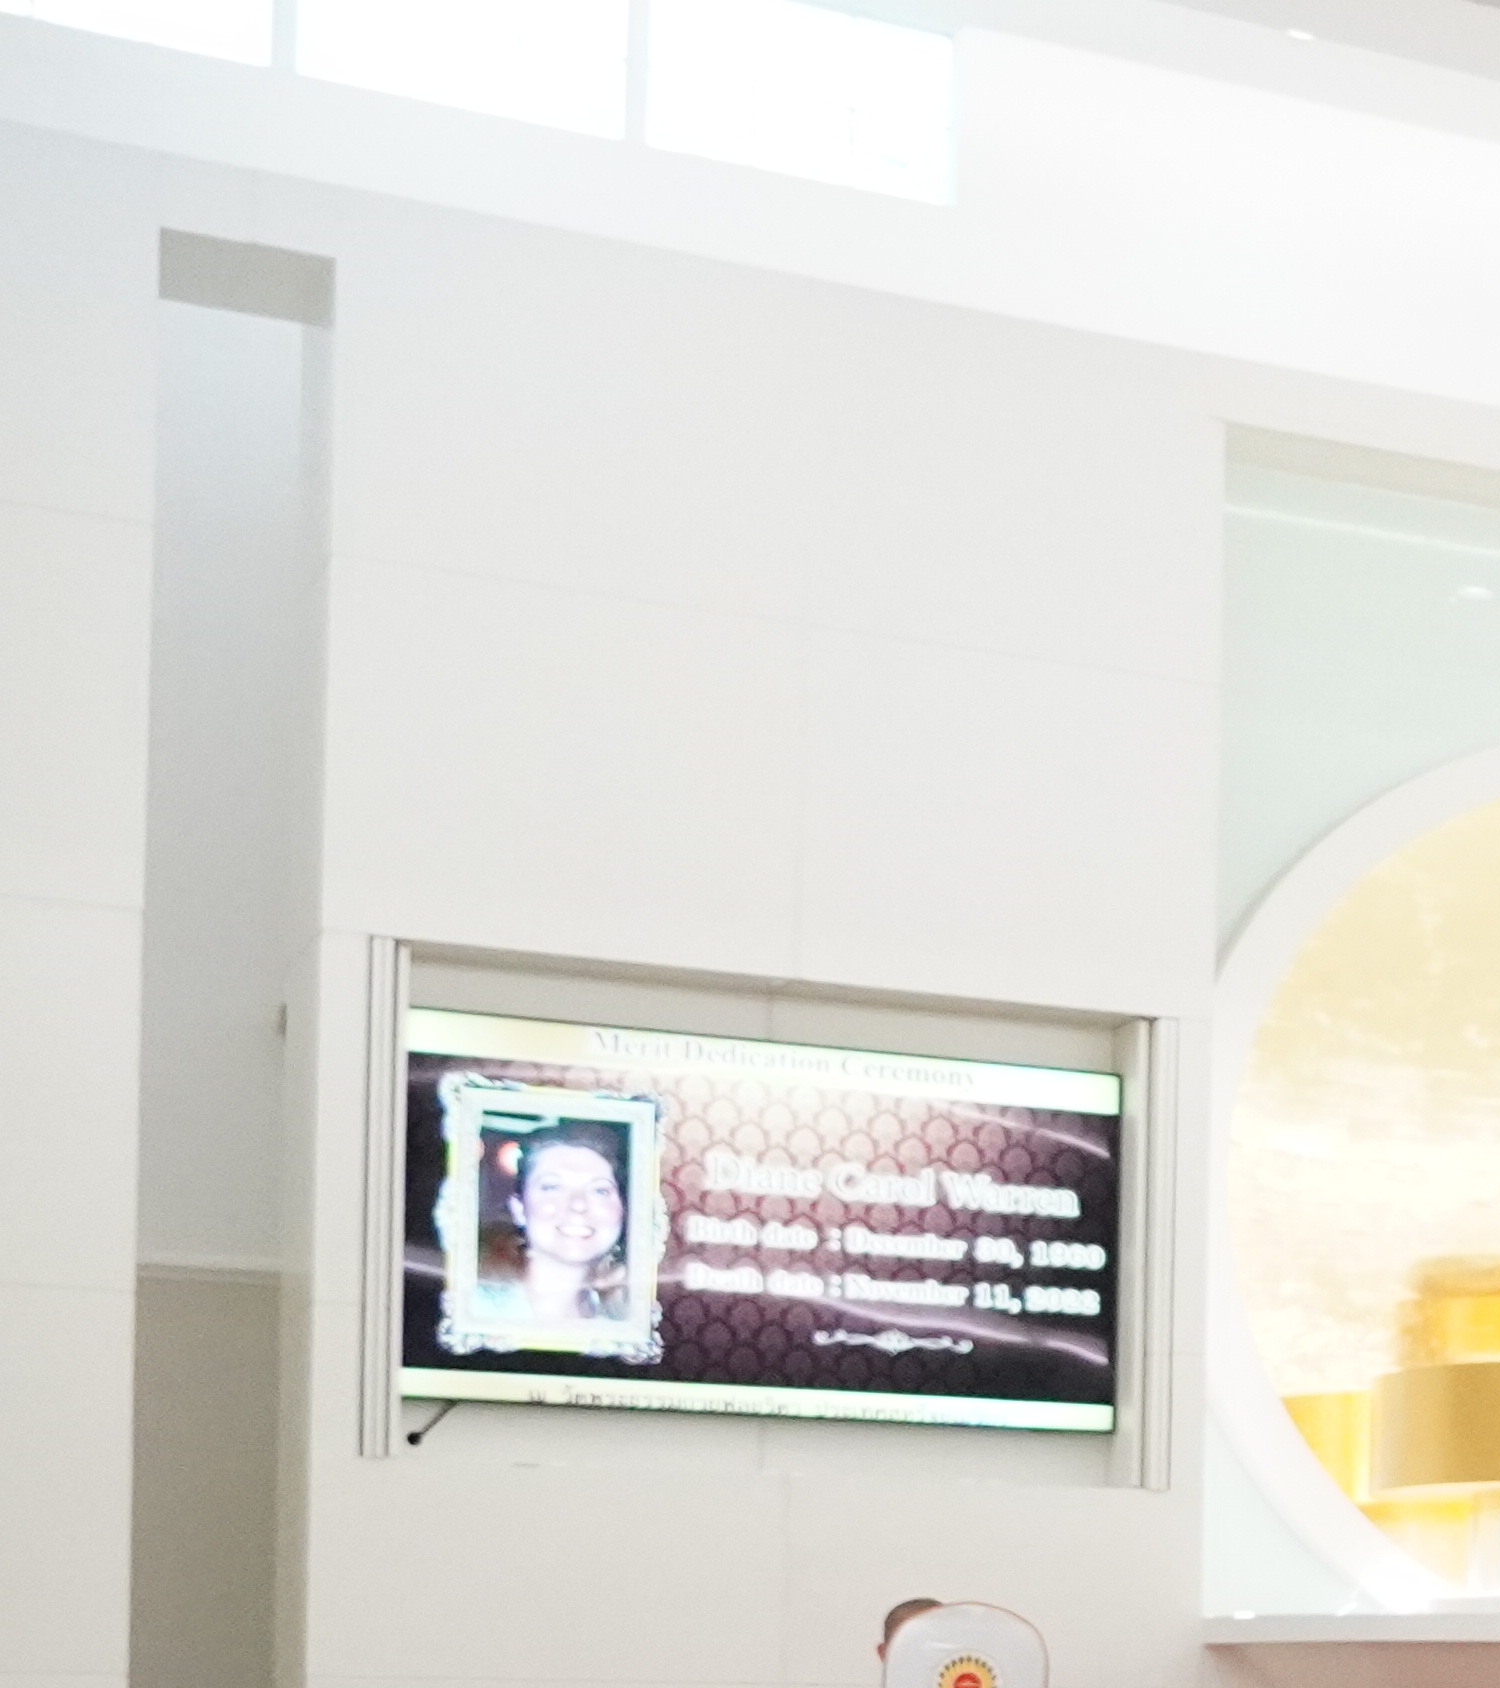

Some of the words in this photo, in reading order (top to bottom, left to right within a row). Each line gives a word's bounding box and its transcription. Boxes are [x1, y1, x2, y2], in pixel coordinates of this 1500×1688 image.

[594, 1031, 672, 1059] Merit
[683, 1040, 831, 1073] Dedication
[840, 1056, 975, 1090] Ceremony
[705, 1152, 823, 1198] Diane
[825, 1164, 937, 1206] Carol
[940, 1171, 1081, 1218] Warren
[686, 1215, 757, 1245] Birth
[760, 1221, 818, 1250] date
[843, 1226, 969, 1262] December
[685, 1261, 764, 1293] Death
[765, 1267, 824, 1298] date
[843, 1273, 969, 1307] November
